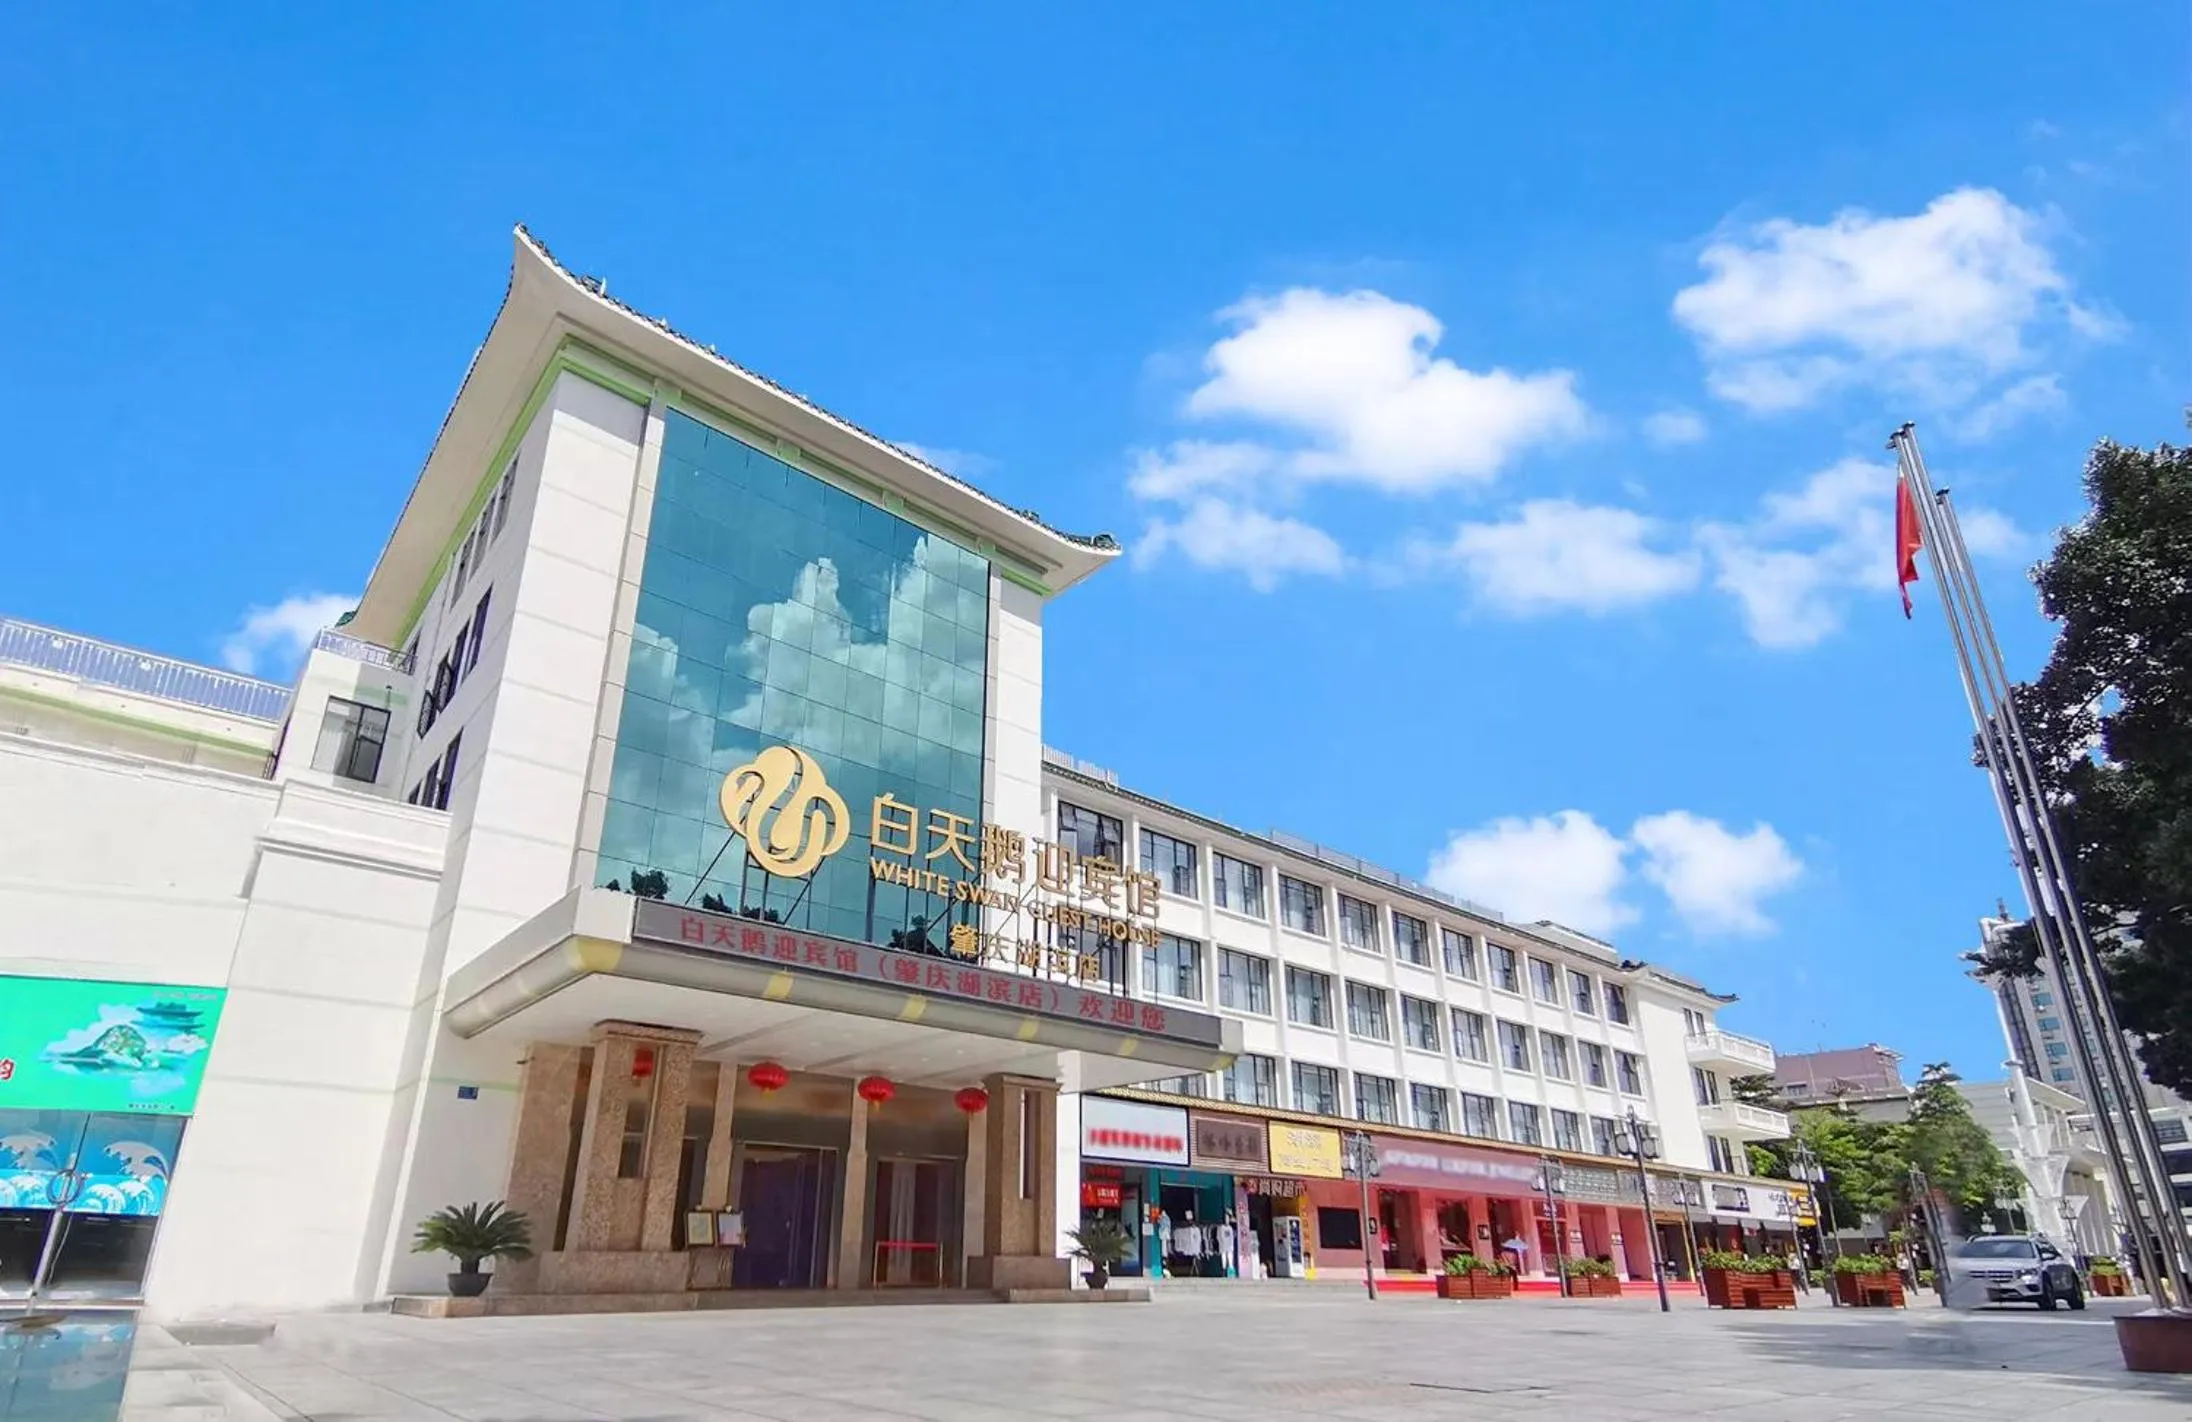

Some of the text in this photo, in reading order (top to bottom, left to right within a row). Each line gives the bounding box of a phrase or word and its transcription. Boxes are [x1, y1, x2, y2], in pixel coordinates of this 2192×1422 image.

[869, 856, 1162, 948] WHITE SWAN GUEST HOUSE
[870, 792, 1161, 919] 白天鹅迎宾馆
